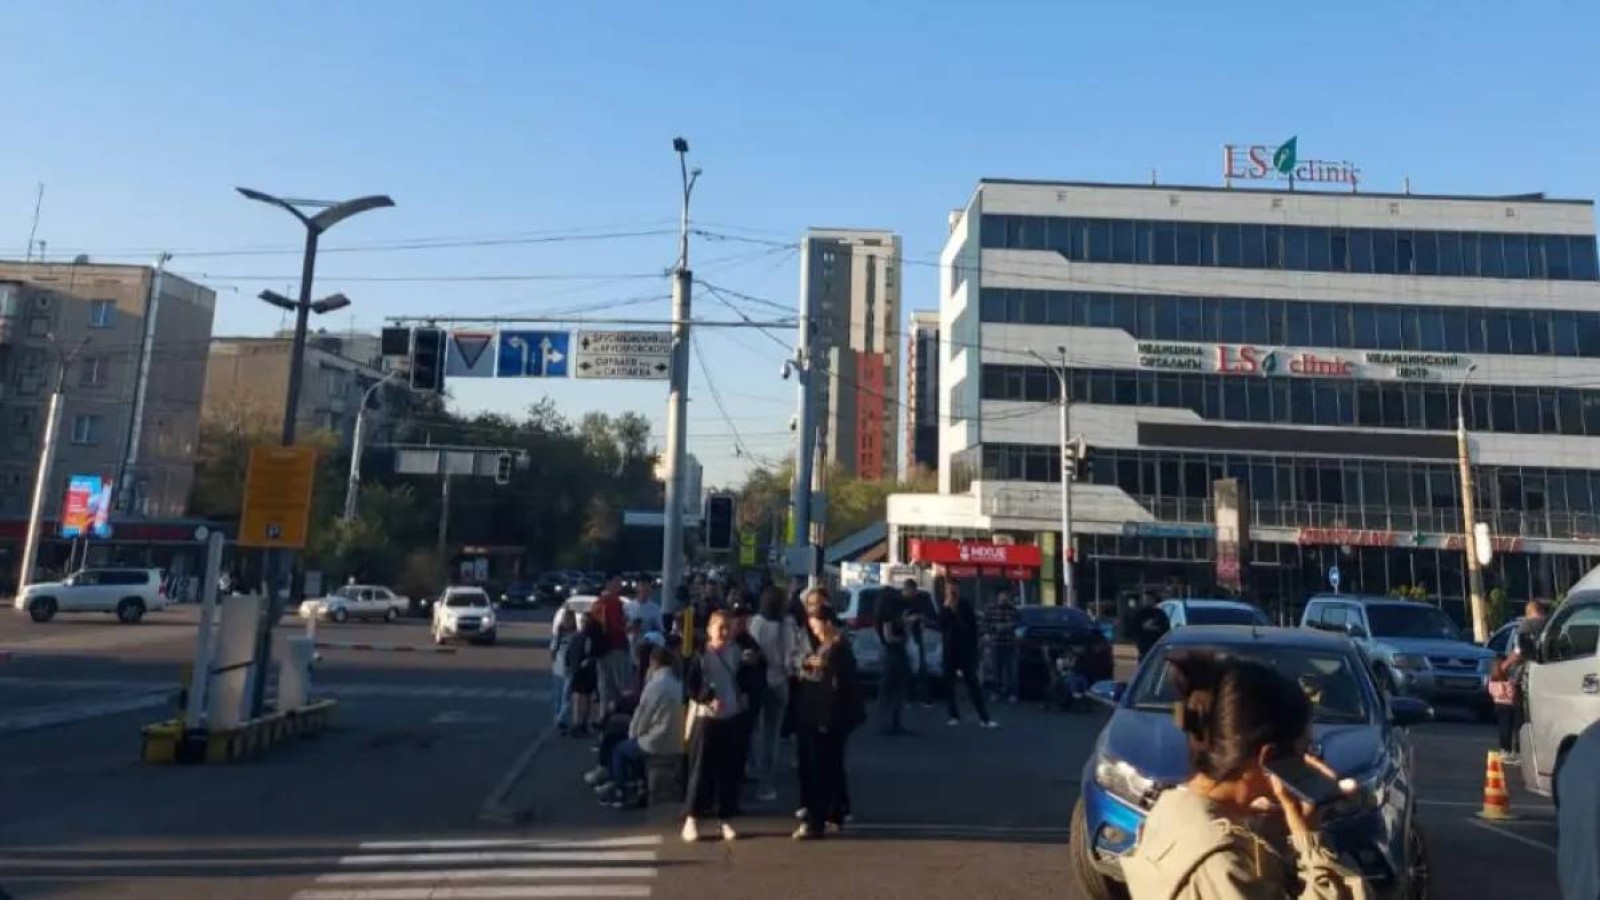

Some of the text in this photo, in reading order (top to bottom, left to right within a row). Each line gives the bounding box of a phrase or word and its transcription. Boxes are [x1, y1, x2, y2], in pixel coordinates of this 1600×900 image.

[1224, 144, 1360, 184] LS clinic
[1216, 345, 1356, 376] LS clinic
[971, 546, 1005, 557] MIXUE
